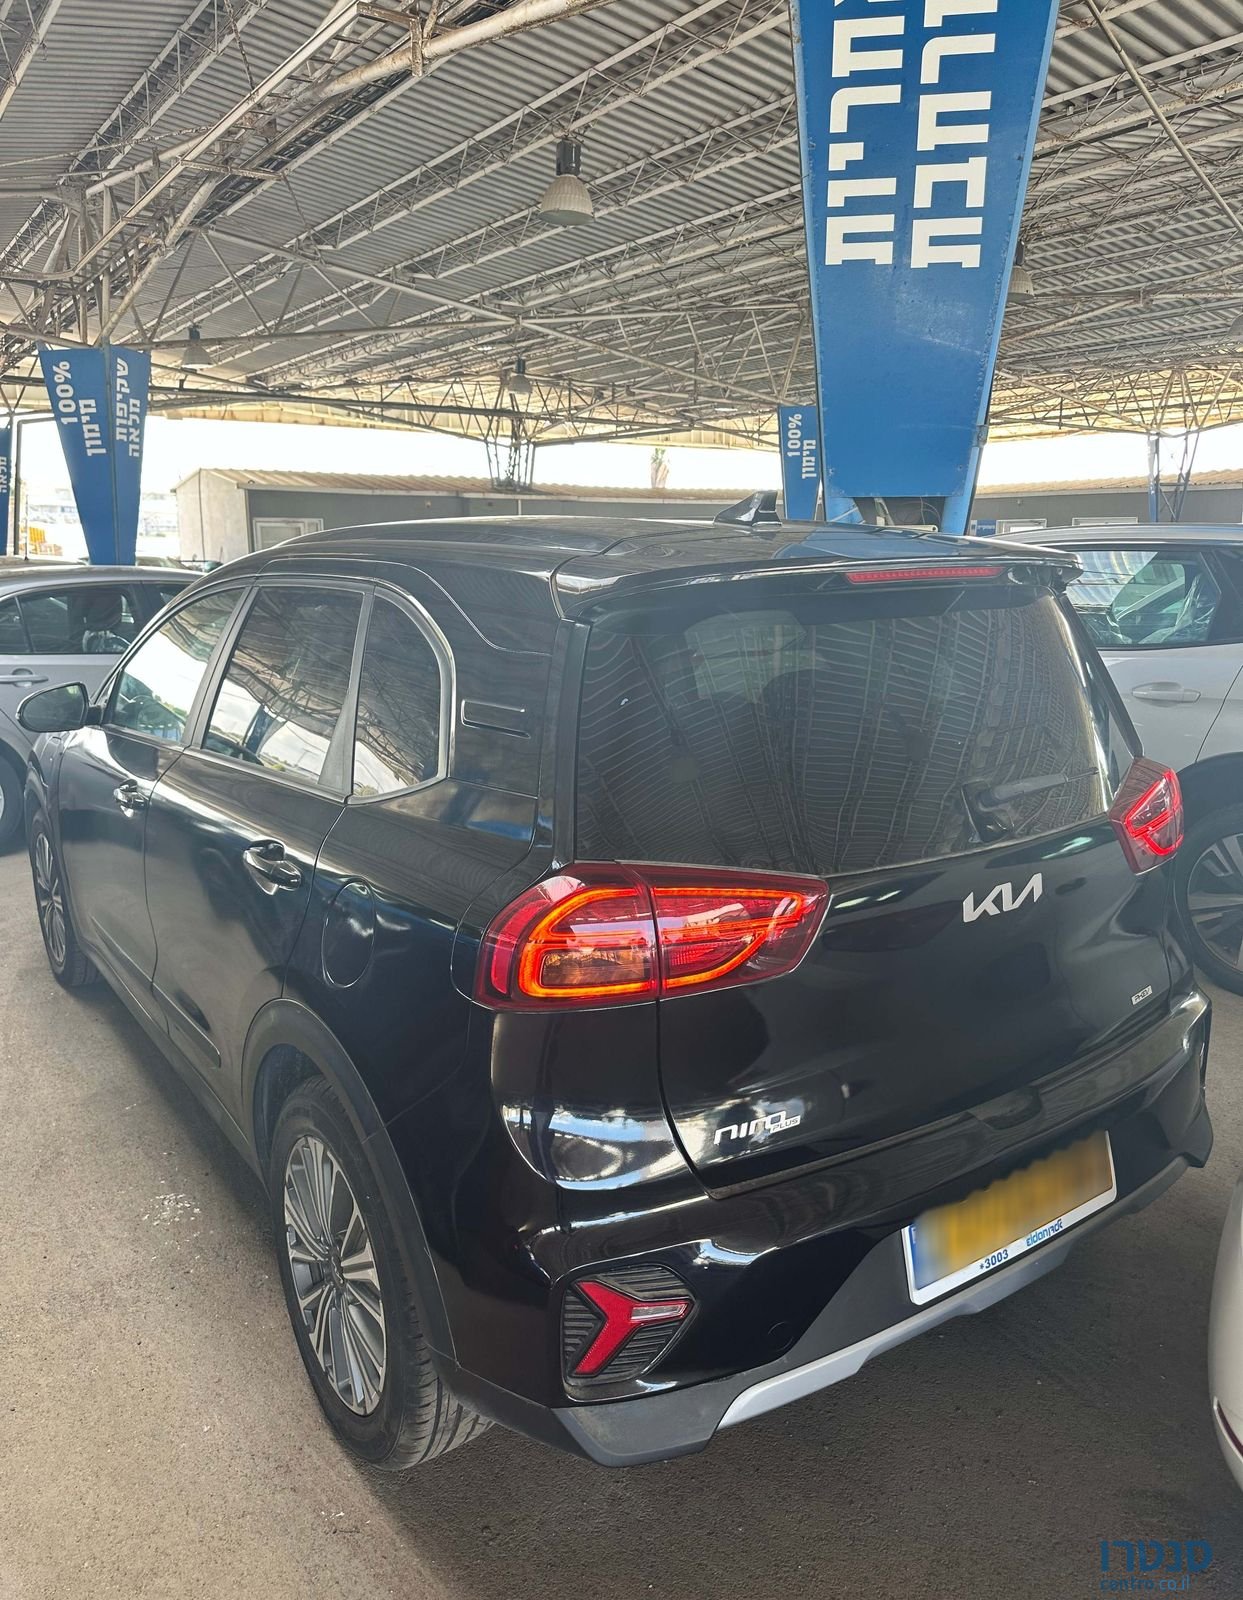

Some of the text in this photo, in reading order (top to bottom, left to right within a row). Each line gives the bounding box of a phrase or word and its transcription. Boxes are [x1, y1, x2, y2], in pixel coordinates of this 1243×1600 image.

[825, 0, 905, 266] חריות
[53, 361, 78, 425] 100%
[116, 358, 130, 442] שקיפות
[79, 398, 106, 456] מימון
[128, 398, 141, 457] מלאה
[787, 413, 802, 457] 100%
[802, 440, 817, 479] מימון
[963, 872, 1043, 923] KIA
[771, 1117, 800, 1133] PLUS
